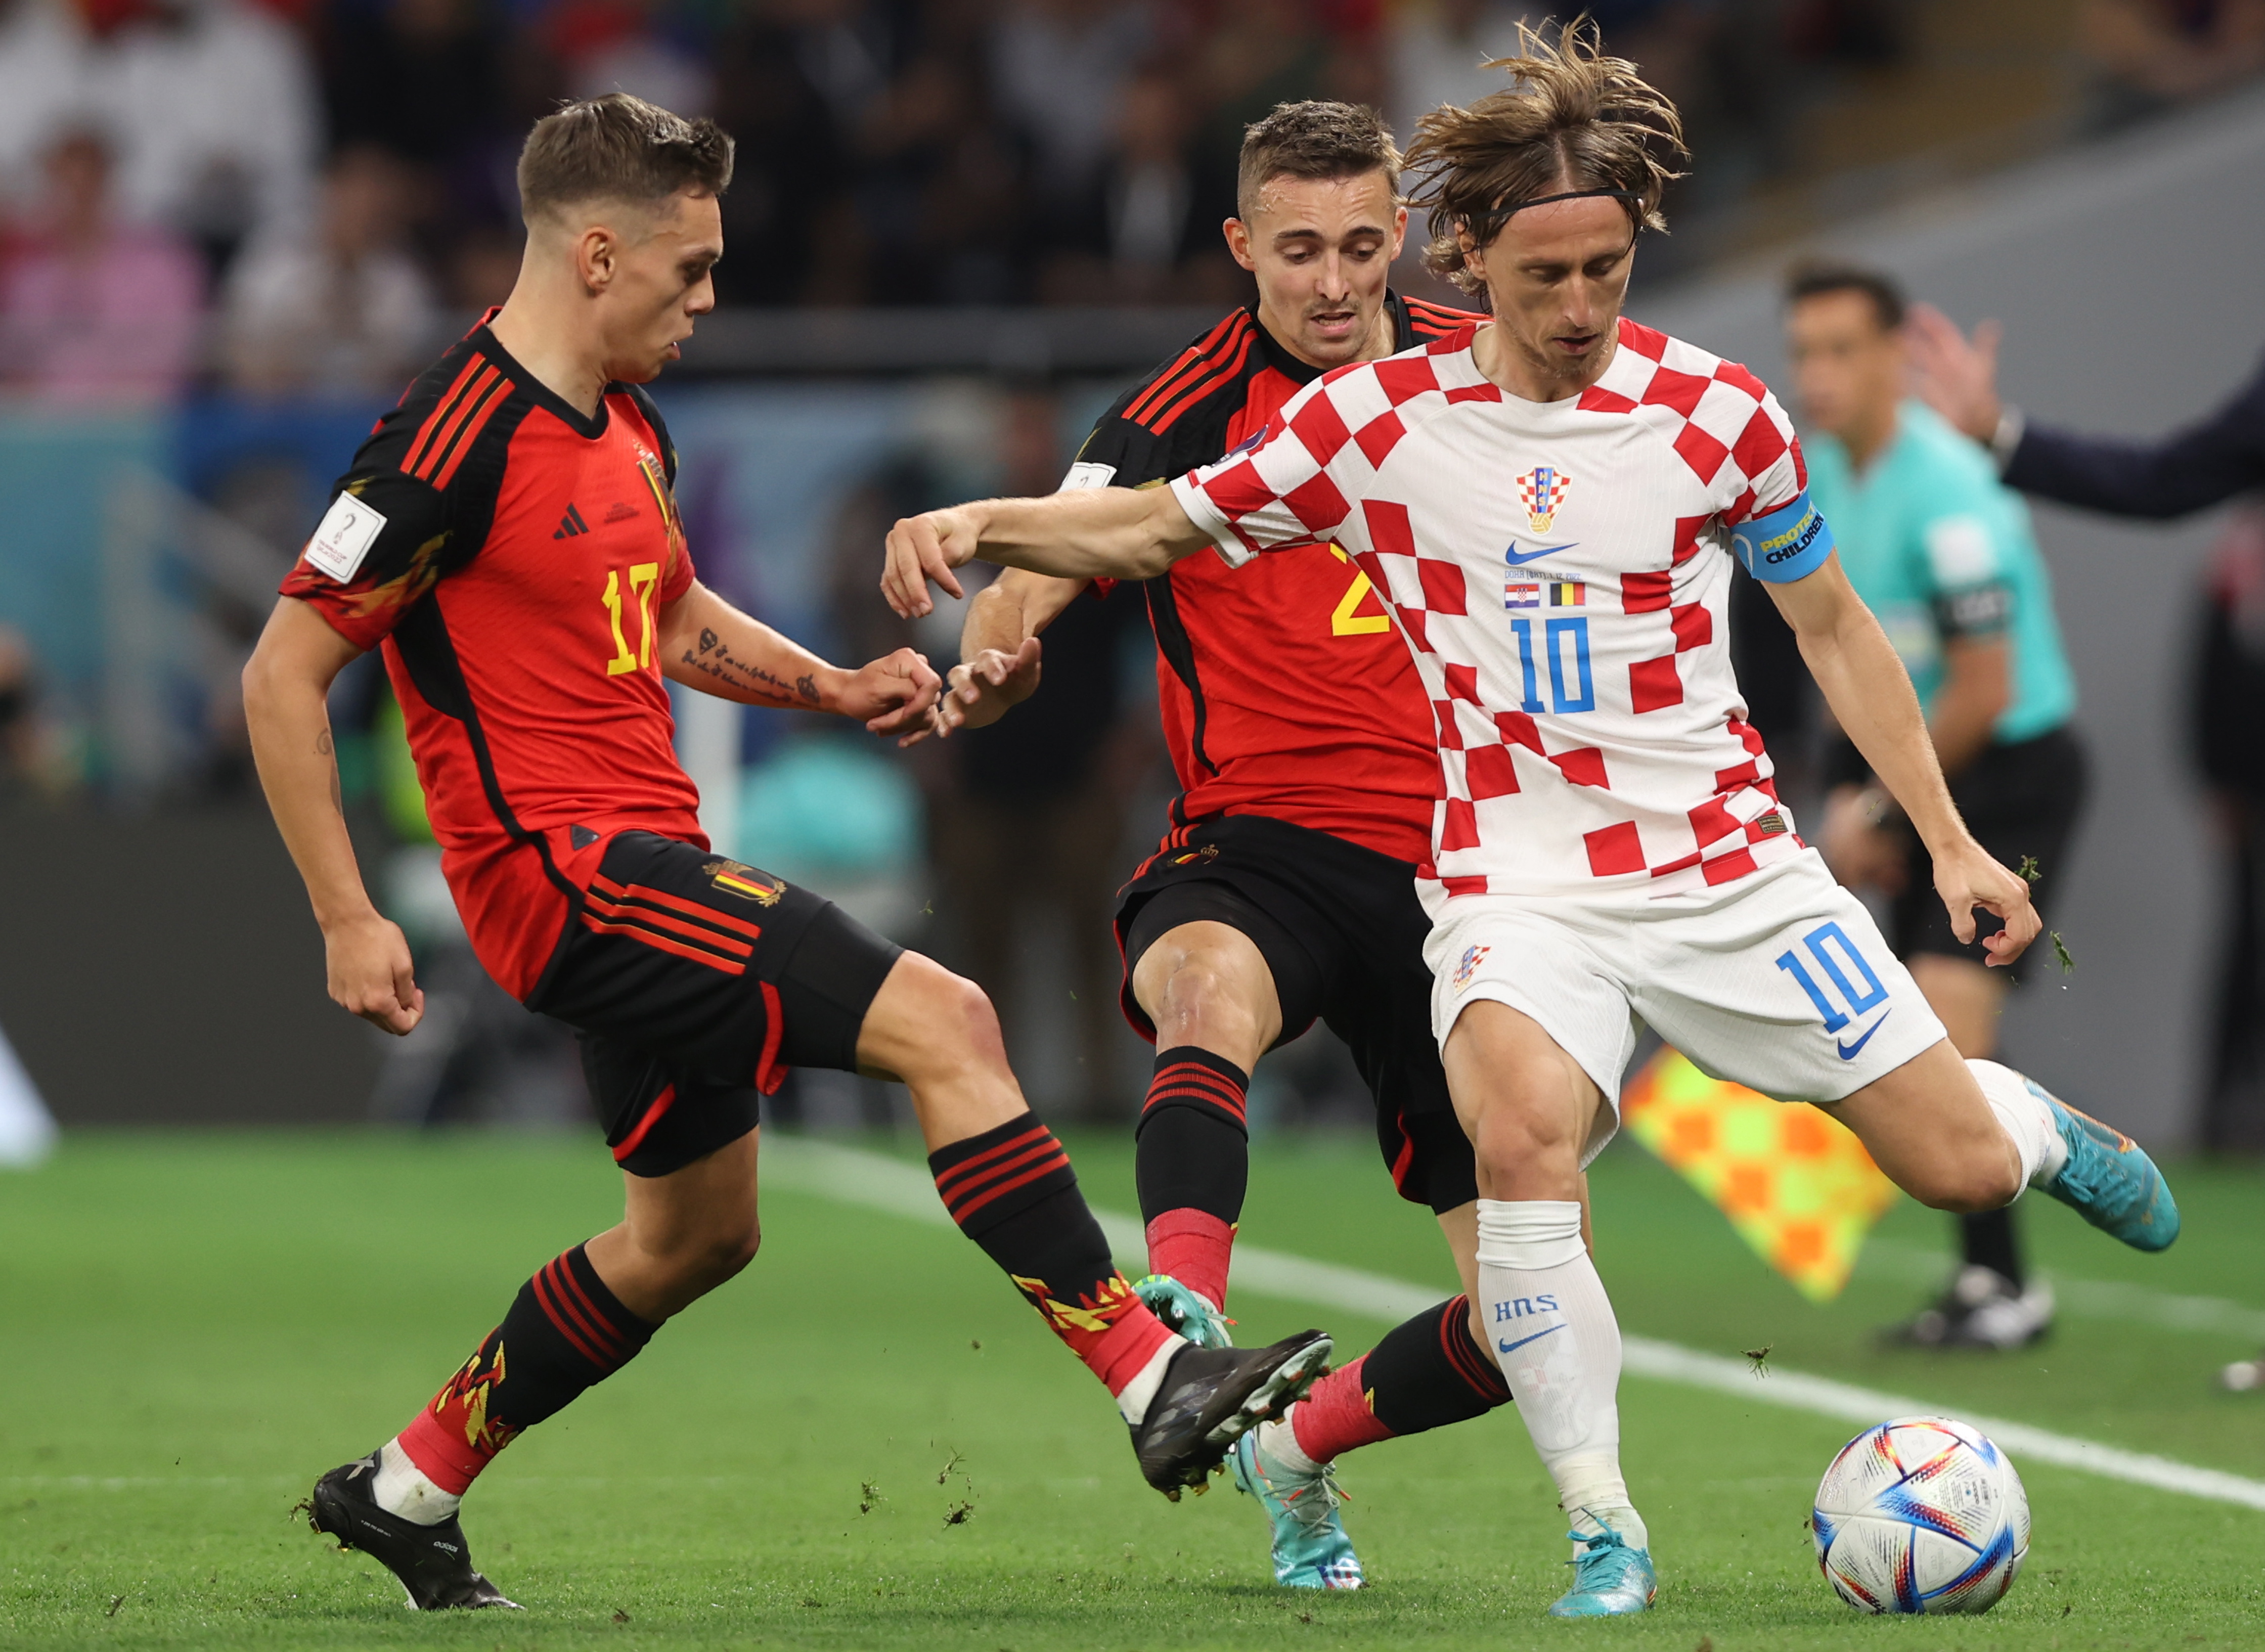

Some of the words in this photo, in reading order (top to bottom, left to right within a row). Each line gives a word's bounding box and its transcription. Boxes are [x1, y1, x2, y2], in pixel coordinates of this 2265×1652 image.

[1538, 471, 1548, 506] HNS
[1505, 570, 1525, 578] DOHA
[1766, 512, 1824, 564] CHILDREN
[601, 562, 658, 676] 17
[1510, 617, 1595, 715] 10
[1774, 921, 1890, 1035] 10
